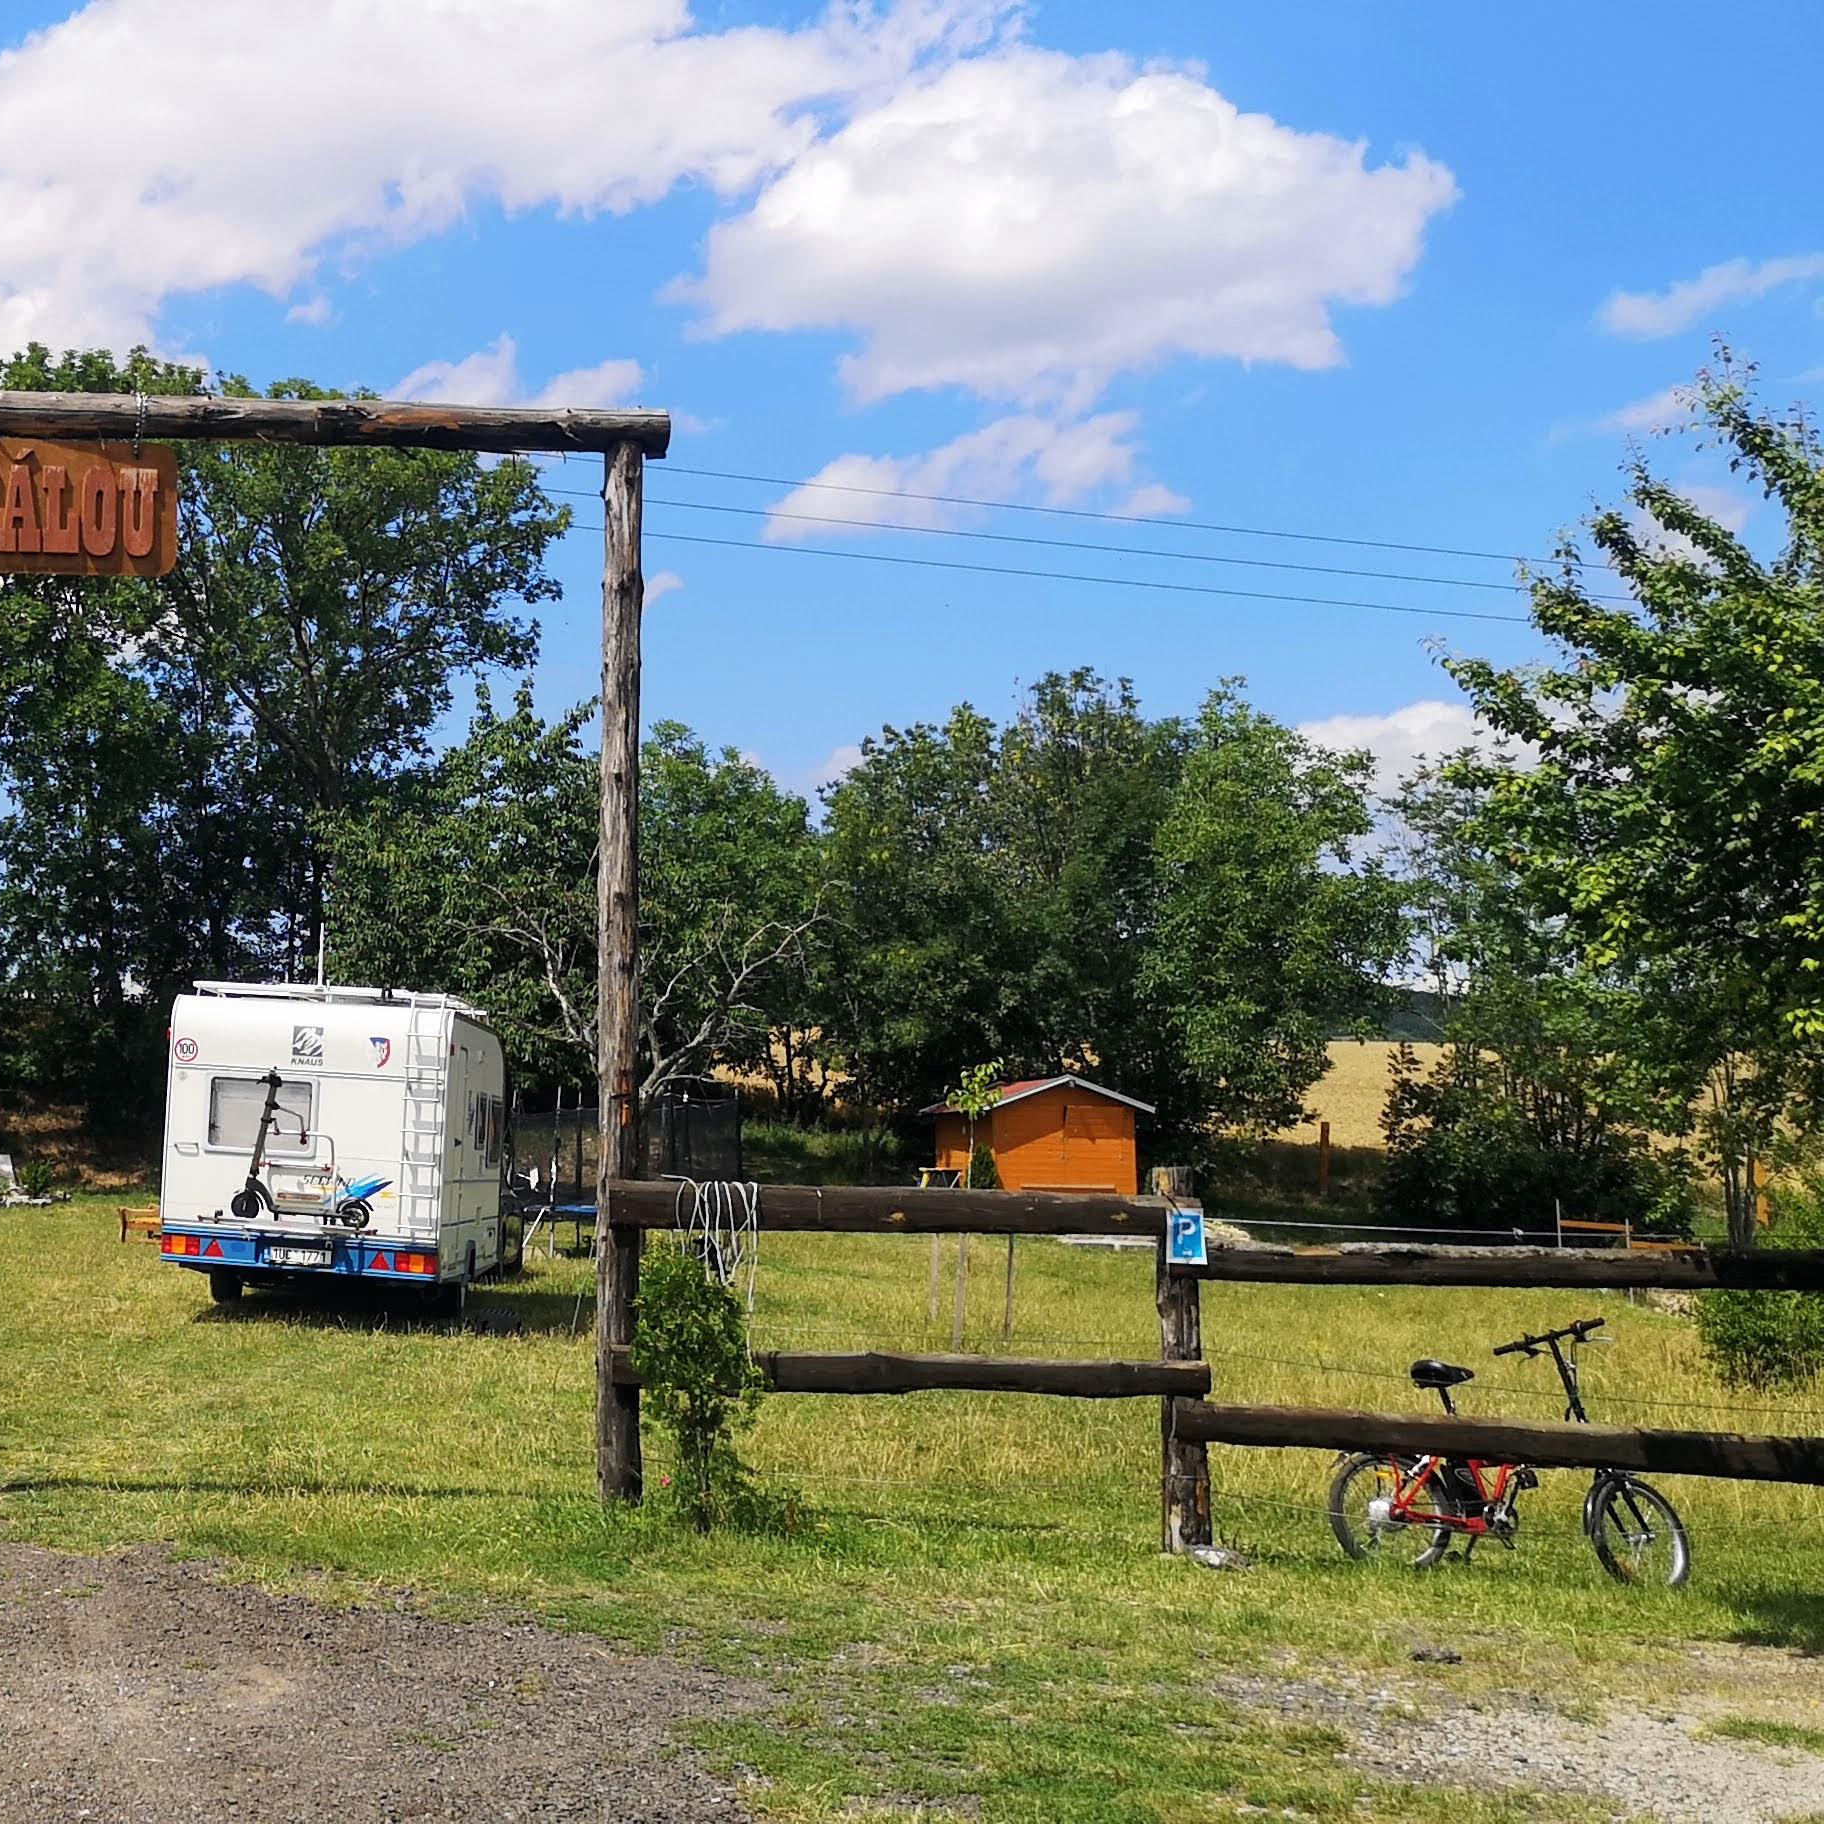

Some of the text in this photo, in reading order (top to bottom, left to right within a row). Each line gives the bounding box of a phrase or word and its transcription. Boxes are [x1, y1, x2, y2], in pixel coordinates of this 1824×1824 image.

[179, 1043, 195, 1055] 100
[291, 1057, 324, 1067] KNAUS
[1178, 1218, 1196, 1245] P
